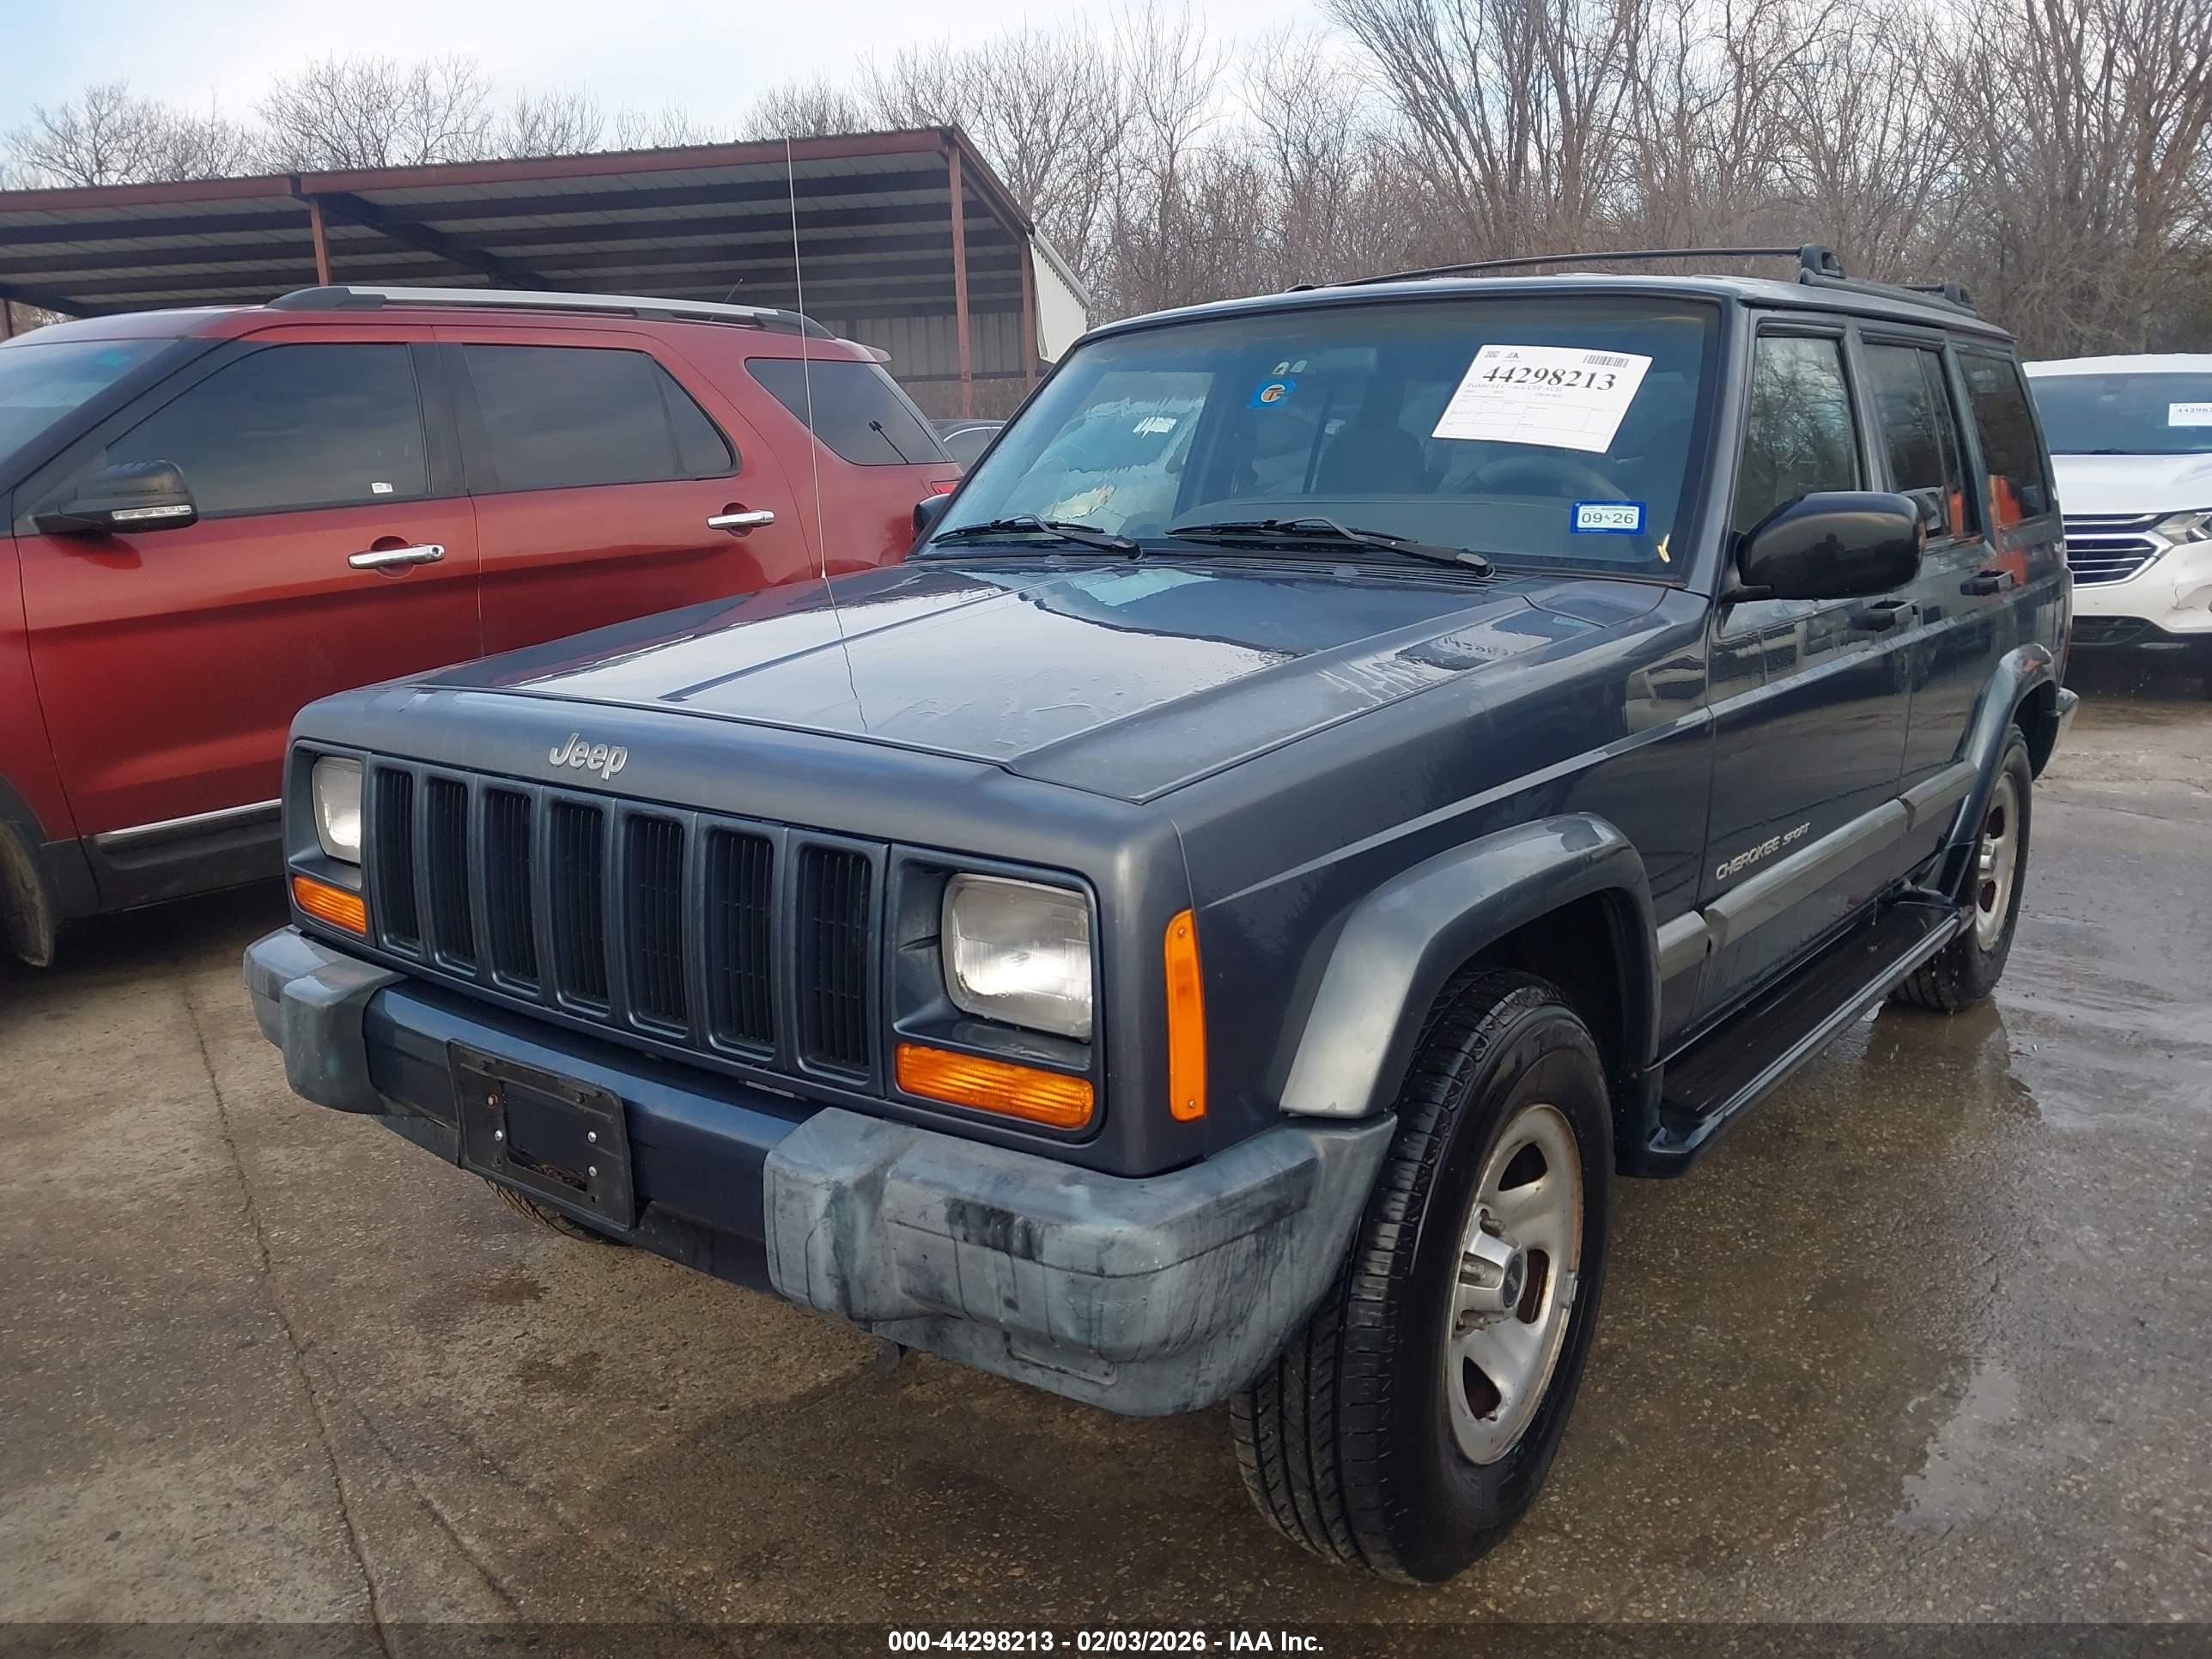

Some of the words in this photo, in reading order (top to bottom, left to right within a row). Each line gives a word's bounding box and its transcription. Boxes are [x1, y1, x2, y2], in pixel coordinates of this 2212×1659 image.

[1482, 365, 1617, 391] 44298213
[1581, 513, 1603, 524] 09
[1612, 513, 1635, 525] 26
[549, 732, 629, 781] Jeep
[1716, 835, 1781, 881] CHEROKEE
[1782, 822, 1812, 846] SPORT
